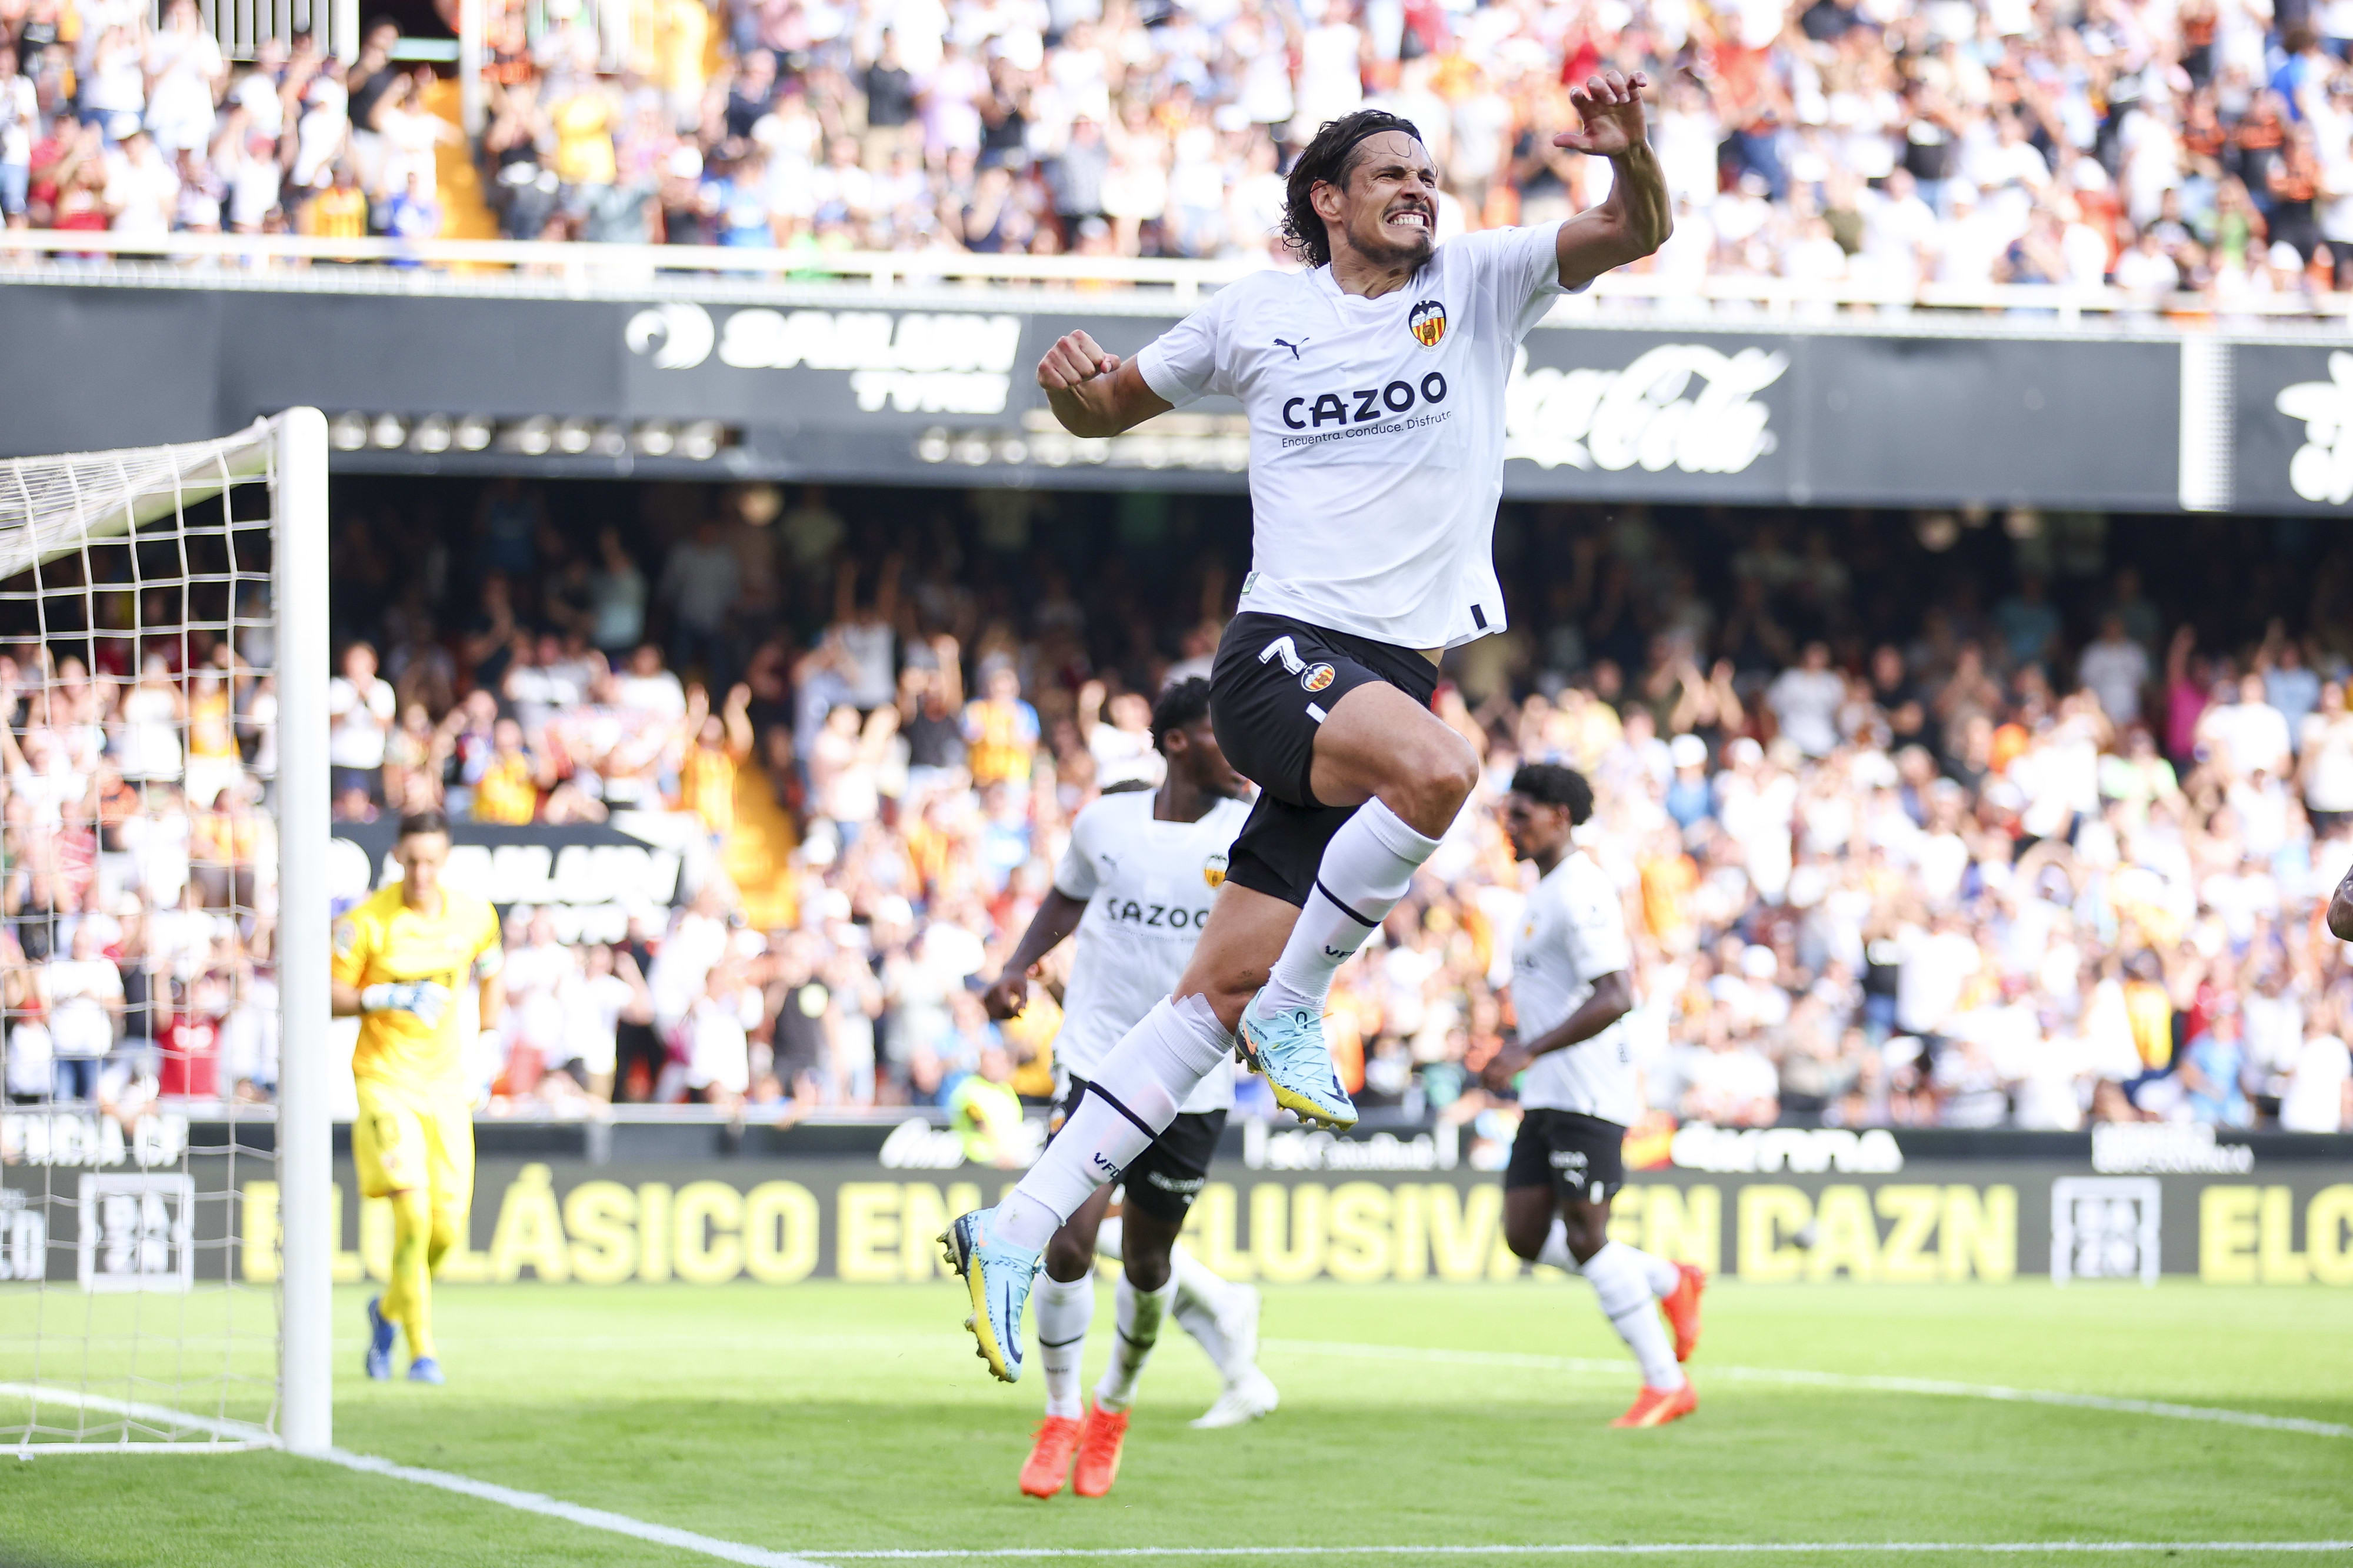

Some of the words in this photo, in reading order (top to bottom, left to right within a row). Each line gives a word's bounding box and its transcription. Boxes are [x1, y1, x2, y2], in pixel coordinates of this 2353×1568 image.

[1283, 372, 1447, 429] CAZOO
[1282, 432, 1344, 448] Encuentra.
[1345, 422, 1404, 438] Conduce.
[1258, 634, 1308, 675] 7
[1325, 945, 1356, 958] VF
